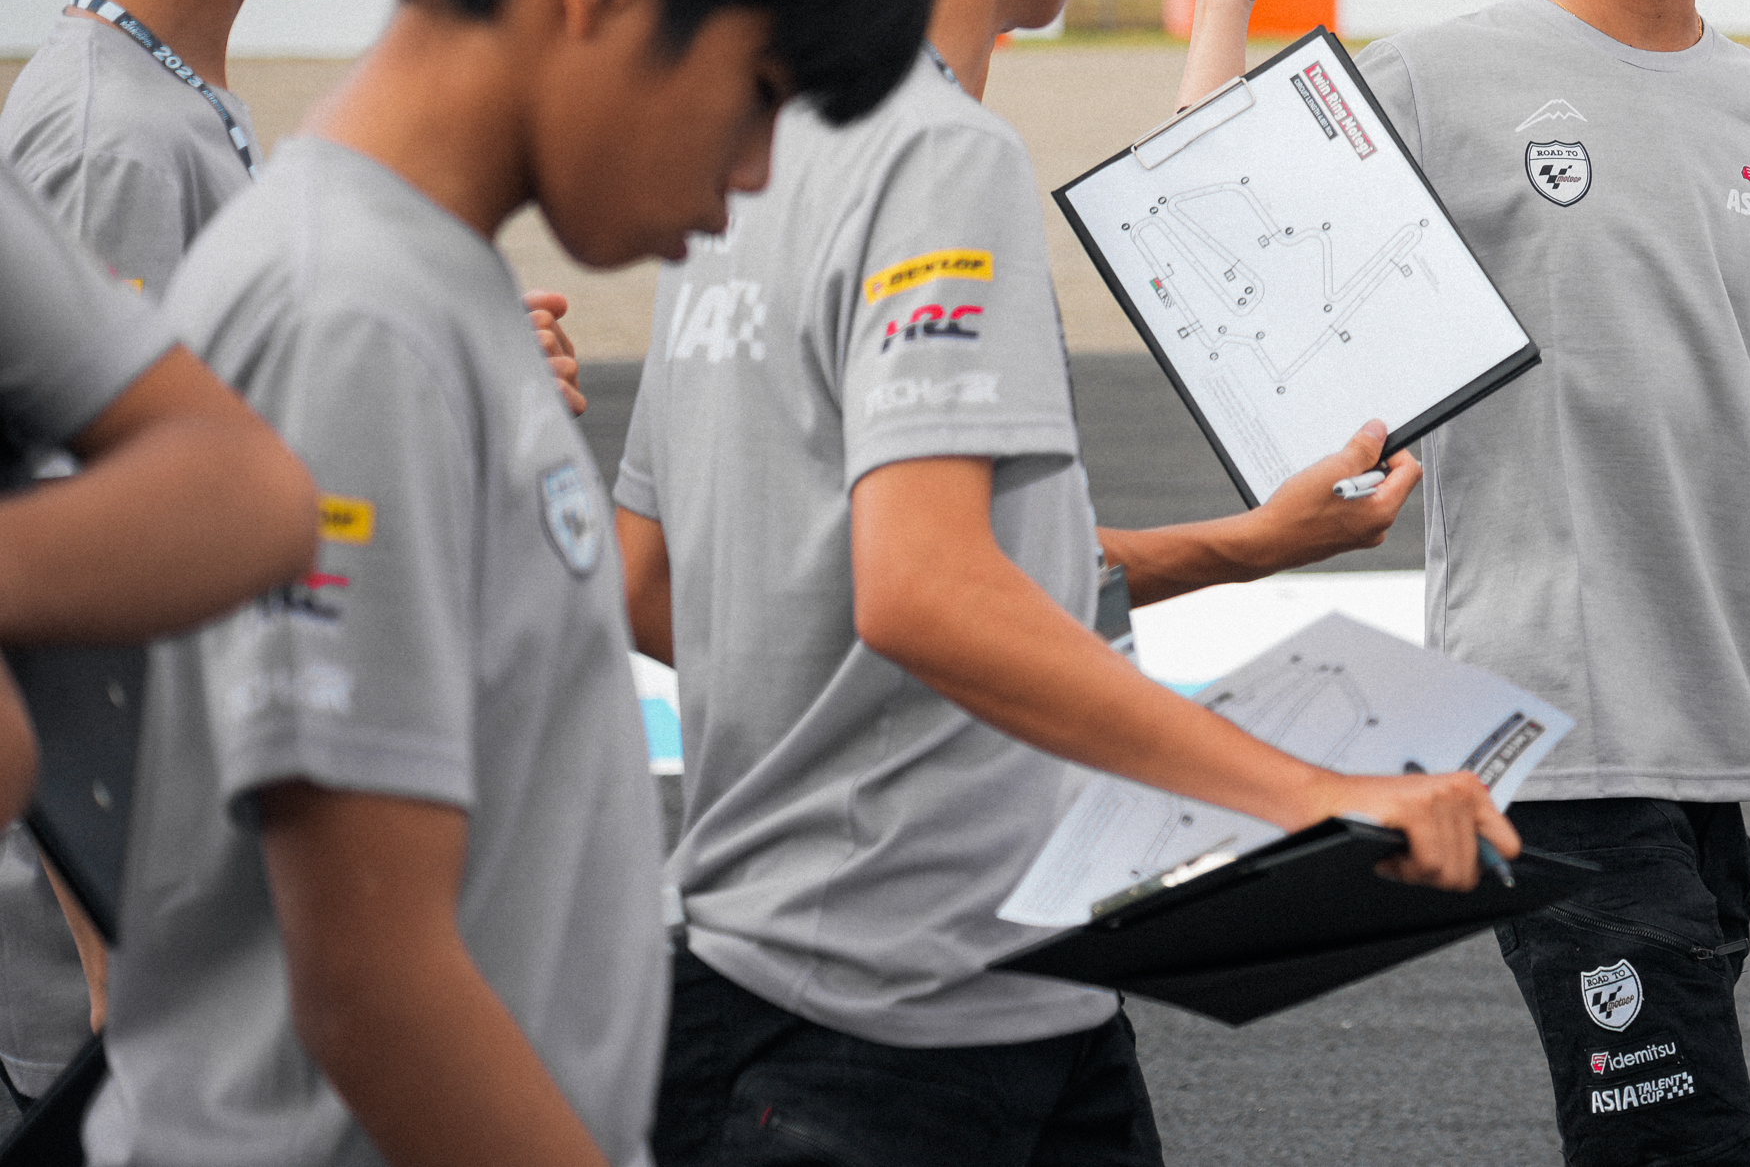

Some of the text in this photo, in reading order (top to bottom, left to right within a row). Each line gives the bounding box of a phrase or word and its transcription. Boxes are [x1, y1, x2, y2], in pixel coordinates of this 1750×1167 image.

[152, 45, 204, 88] 2023
[1309, 64, 1374, 156] Twin Ring Motegi
[1536, 149, 1564, 157] ROAD
[882, 303, 985, 354] HRC
[1586, 969, 1626, 987] ROAD TO
[1607, 1042, 1676, 1072] idemitsu
[1592, 1074, 1682, 1114] ASIA TALENT
[1640, 1089, 1665, 1105] CUP
